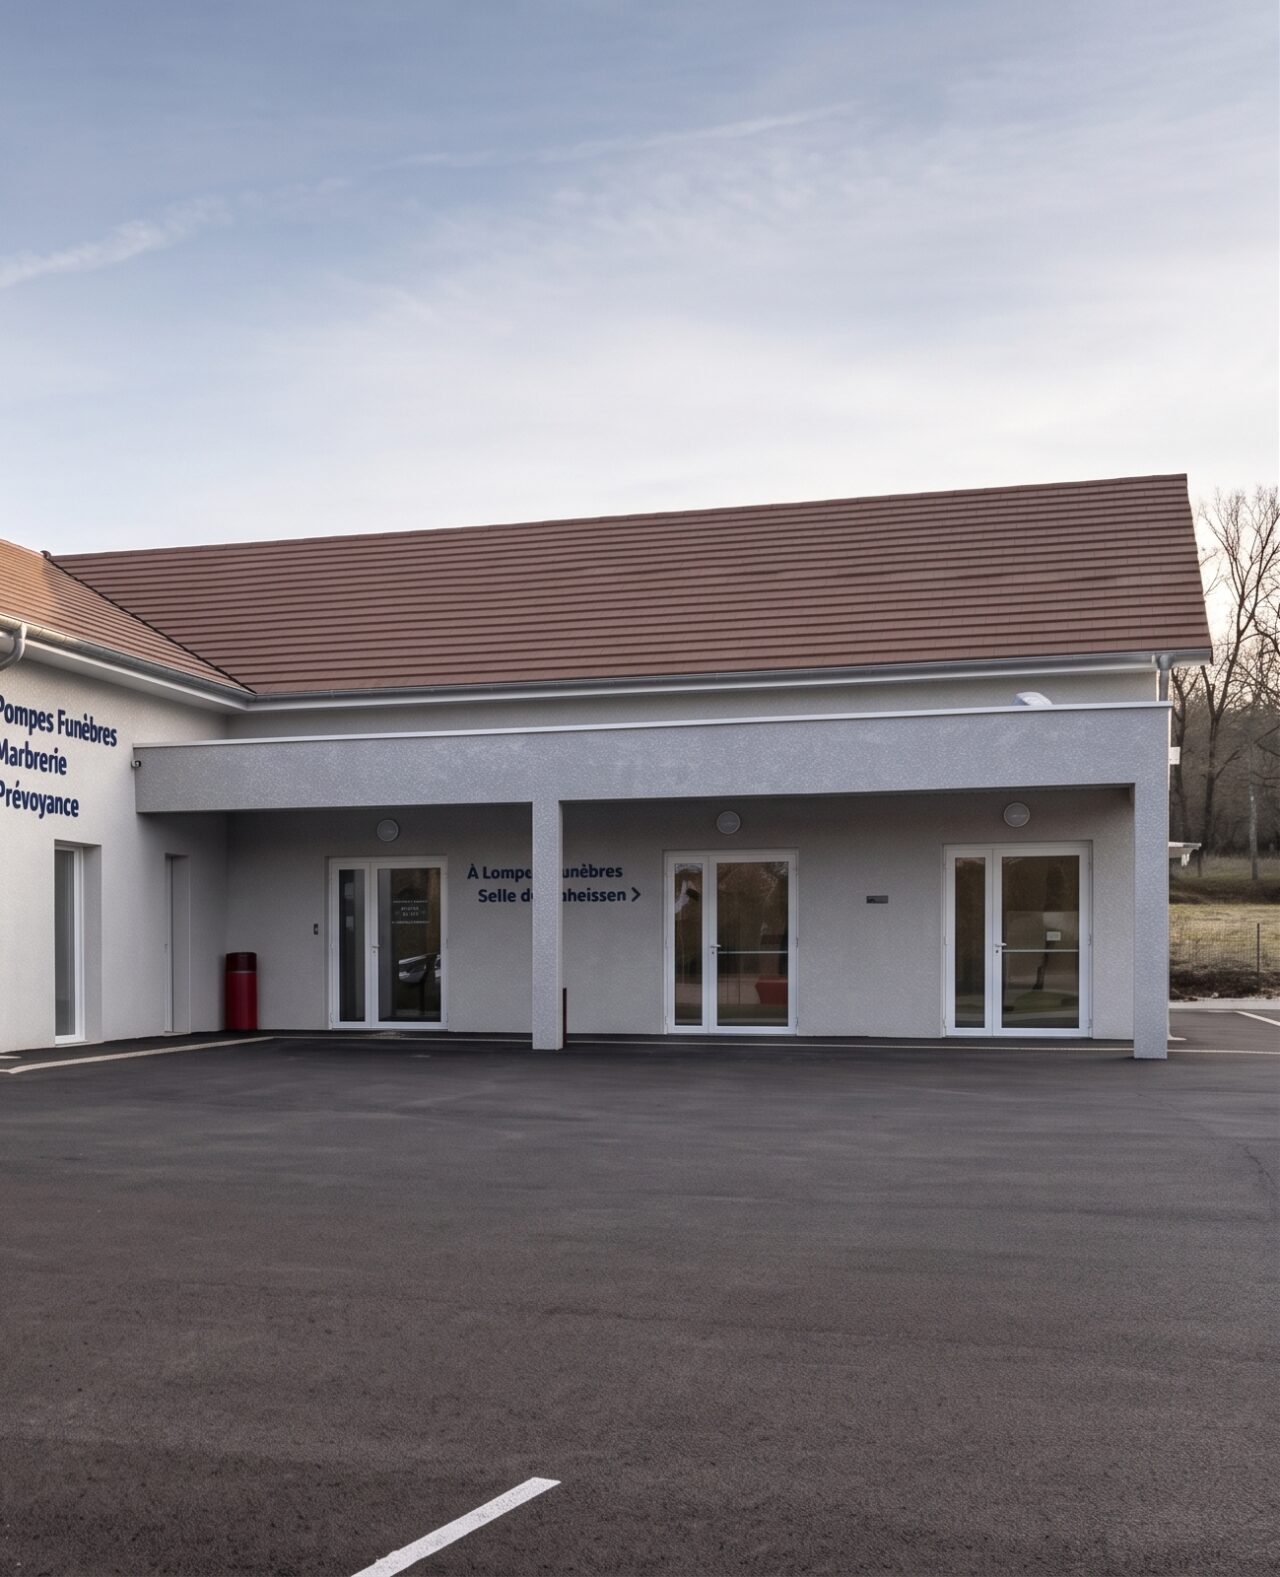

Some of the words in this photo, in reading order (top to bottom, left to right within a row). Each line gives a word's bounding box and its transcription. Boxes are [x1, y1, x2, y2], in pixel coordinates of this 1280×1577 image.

[57, 708, 118, 748] Funèbres
[482, 865, 533, 883] Lompe
[563, 862, 624, 879] unèbres
[478, 887, 517, 903] Selle
